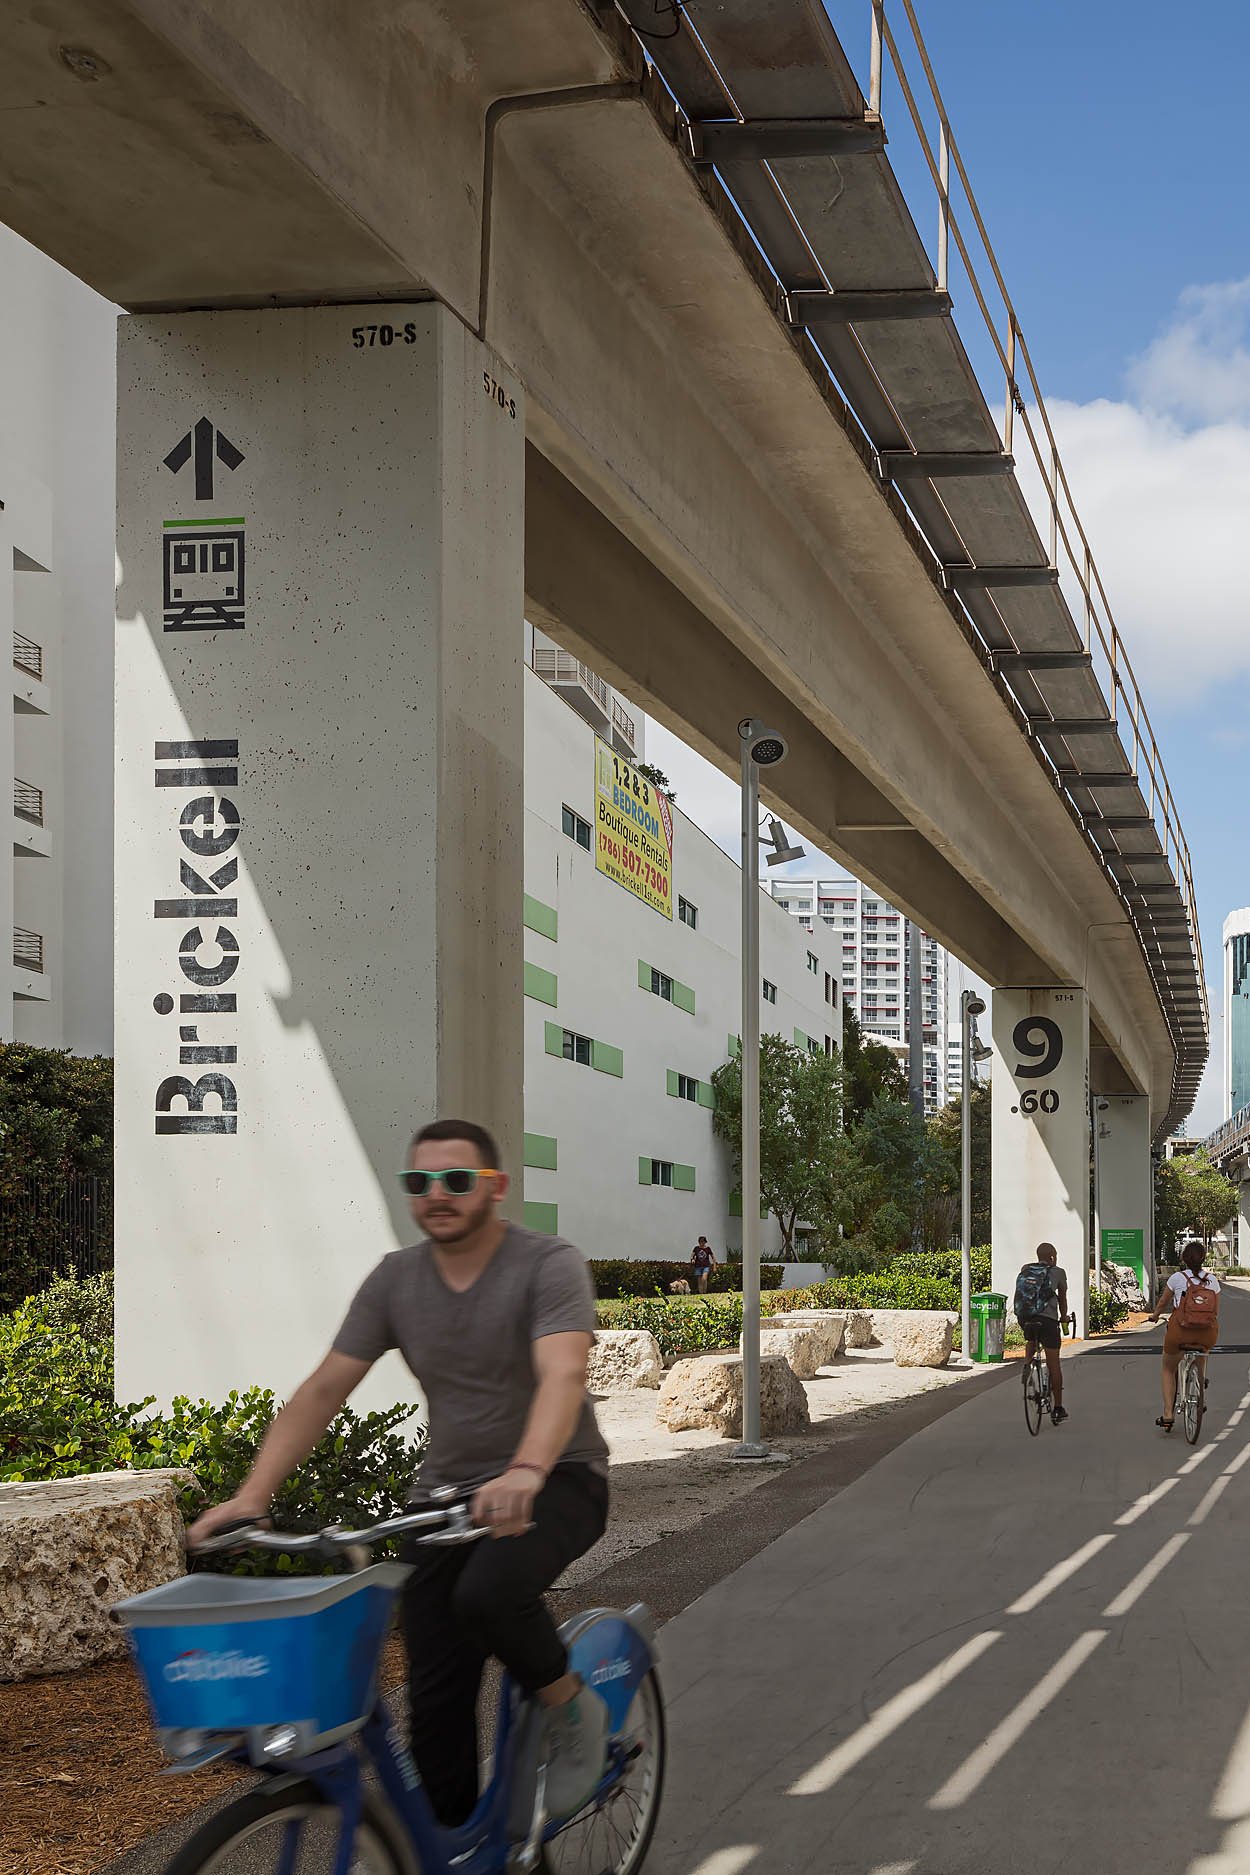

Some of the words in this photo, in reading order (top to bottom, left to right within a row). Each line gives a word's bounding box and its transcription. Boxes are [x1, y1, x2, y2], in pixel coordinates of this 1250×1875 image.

[352, 322, 417, 348] 570-S
[483, 371, 516, 420] 570-S
[613, 784, 659, 841] BEDROOM
[633, 774, 641, 799] &
[643, 783, 649, 805] 3
[599, 800, 639, 847] Boutique
[640, 834, 668, 872] Rentals
[599, 832, 621, 864] (786)
[622, 844, 668, 898] 507-7300
[153, 739, 241, 1135] Brickell
[1012, 1016, 1063, 1079] 9
[1010, 1088, 1060, 1114] .60
